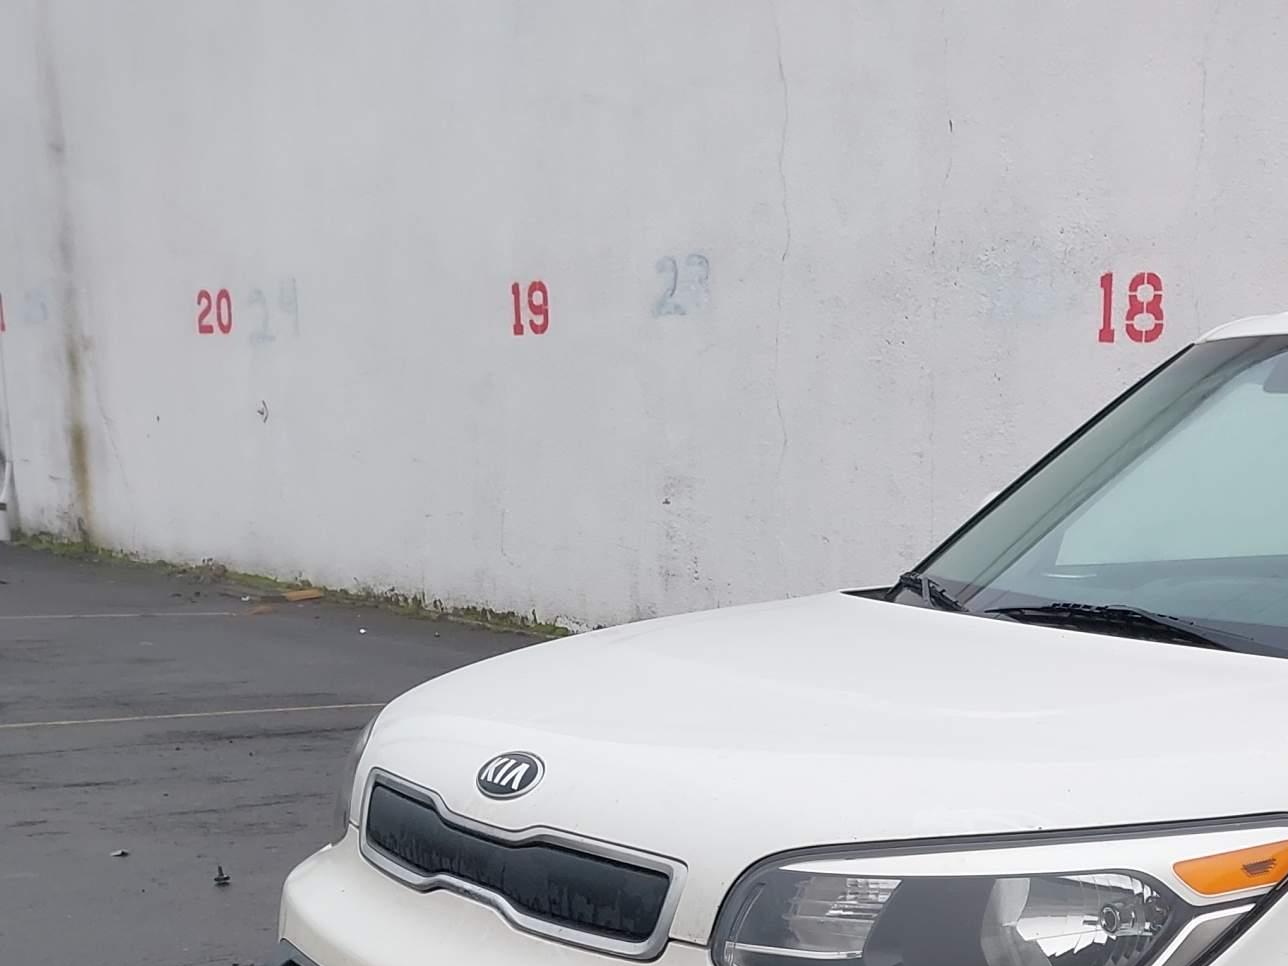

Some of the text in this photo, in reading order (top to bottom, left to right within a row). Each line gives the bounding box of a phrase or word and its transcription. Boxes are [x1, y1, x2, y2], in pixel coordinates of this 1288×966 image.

[197, 288, 232, 334] 20
[511, 280, 549, 336] 19
[1098, 271, 1166, 344] 18
[480, 757, 530, 790] KIA
